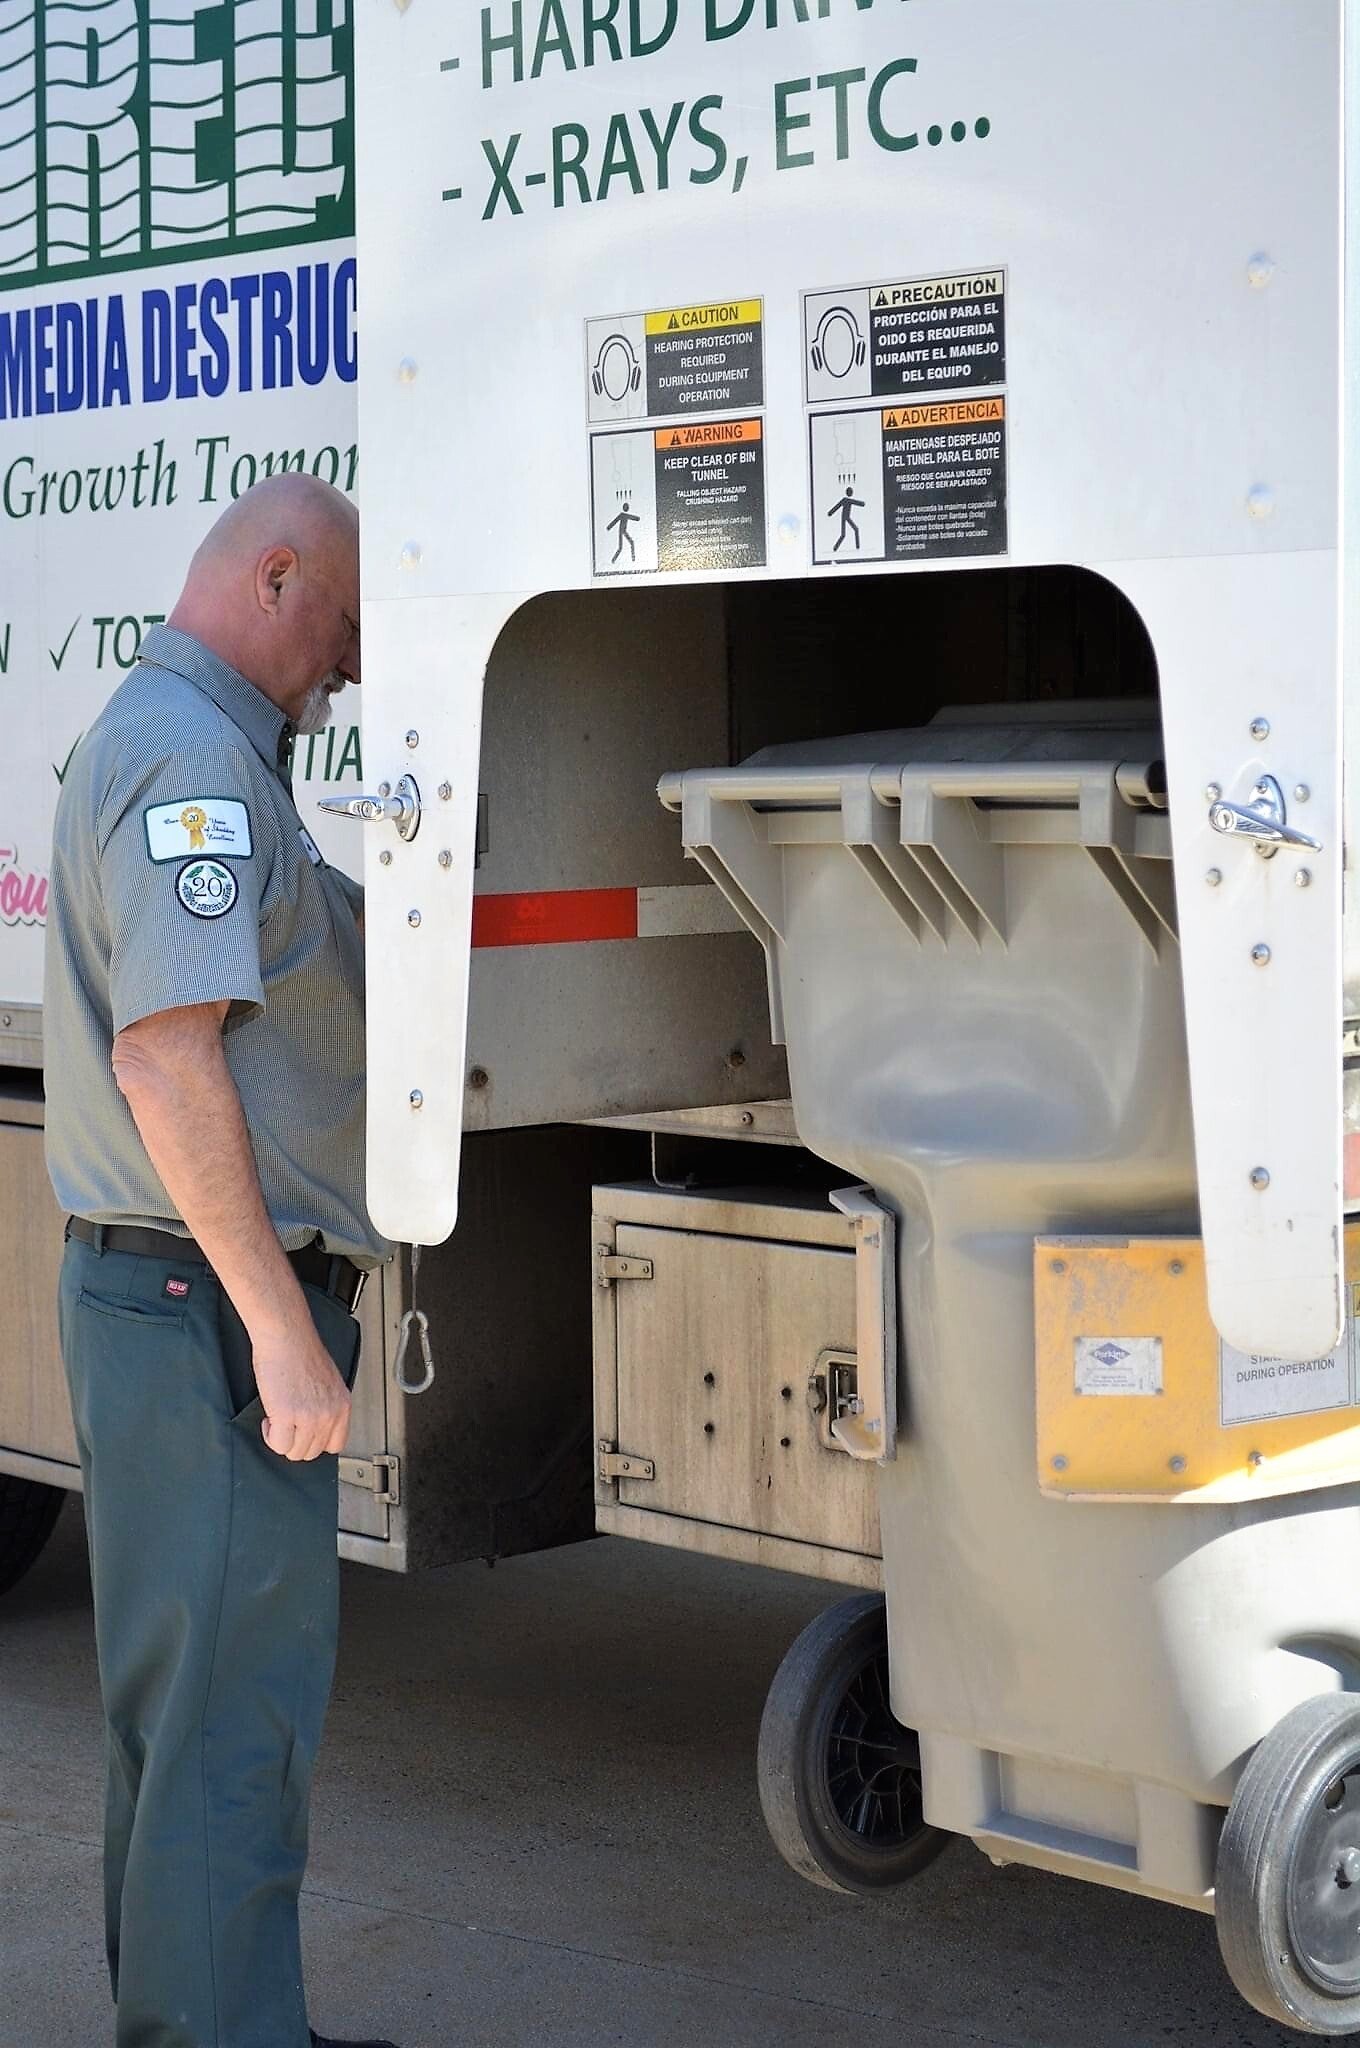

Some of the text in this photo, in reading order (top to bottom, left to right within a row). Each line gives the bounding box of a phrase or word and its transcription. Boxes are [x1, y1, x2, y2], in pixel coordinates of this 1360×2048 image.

[481, 0, 678, 89] HARD
[481, 94, 749, 220] X-RAYS,
[774, 57, 991, 170] ETC...
[682, 306, 739, 326] CAUTION
[874, 302, 999, 328] PROTECCIÓN PARA EL
[654, 332, 753, 353] HEARING PROTECTION
[879, 322, 995, 346] OIDO ES REQUERIDA
[0, 294, 131, 420] MEDIA
[681, 353, 726, 368] REQUIRED
[875, 342, 999, 366] DURANTE EL MANEJO
[658, 368, 749, 388] DURING EQUIPMENT
[902, 365, 971, 382] DEL EQUIPO
[679, 388, 730, 403] OPERATION
[901, 402, 999, 425] ADVERTENCIA
[684, 424, 743, 442] WARNING
[886, 431, 1001, 452] MANTENGASE DESPEJADO
[664, 451, 756, 470] KEEP CLEAR OF BIN
[888, 447, 1000, 467] DEL TUNEL PARA EL BOTE
[3, 438, 178, 519] Growth
[691, 468, 729, 481] TUNNEL
[192, 877, 223, 898] 20
[1236, 1367, 1275, 1383] DURING
[1278, 1359, 1335, 1376] OPERATION
